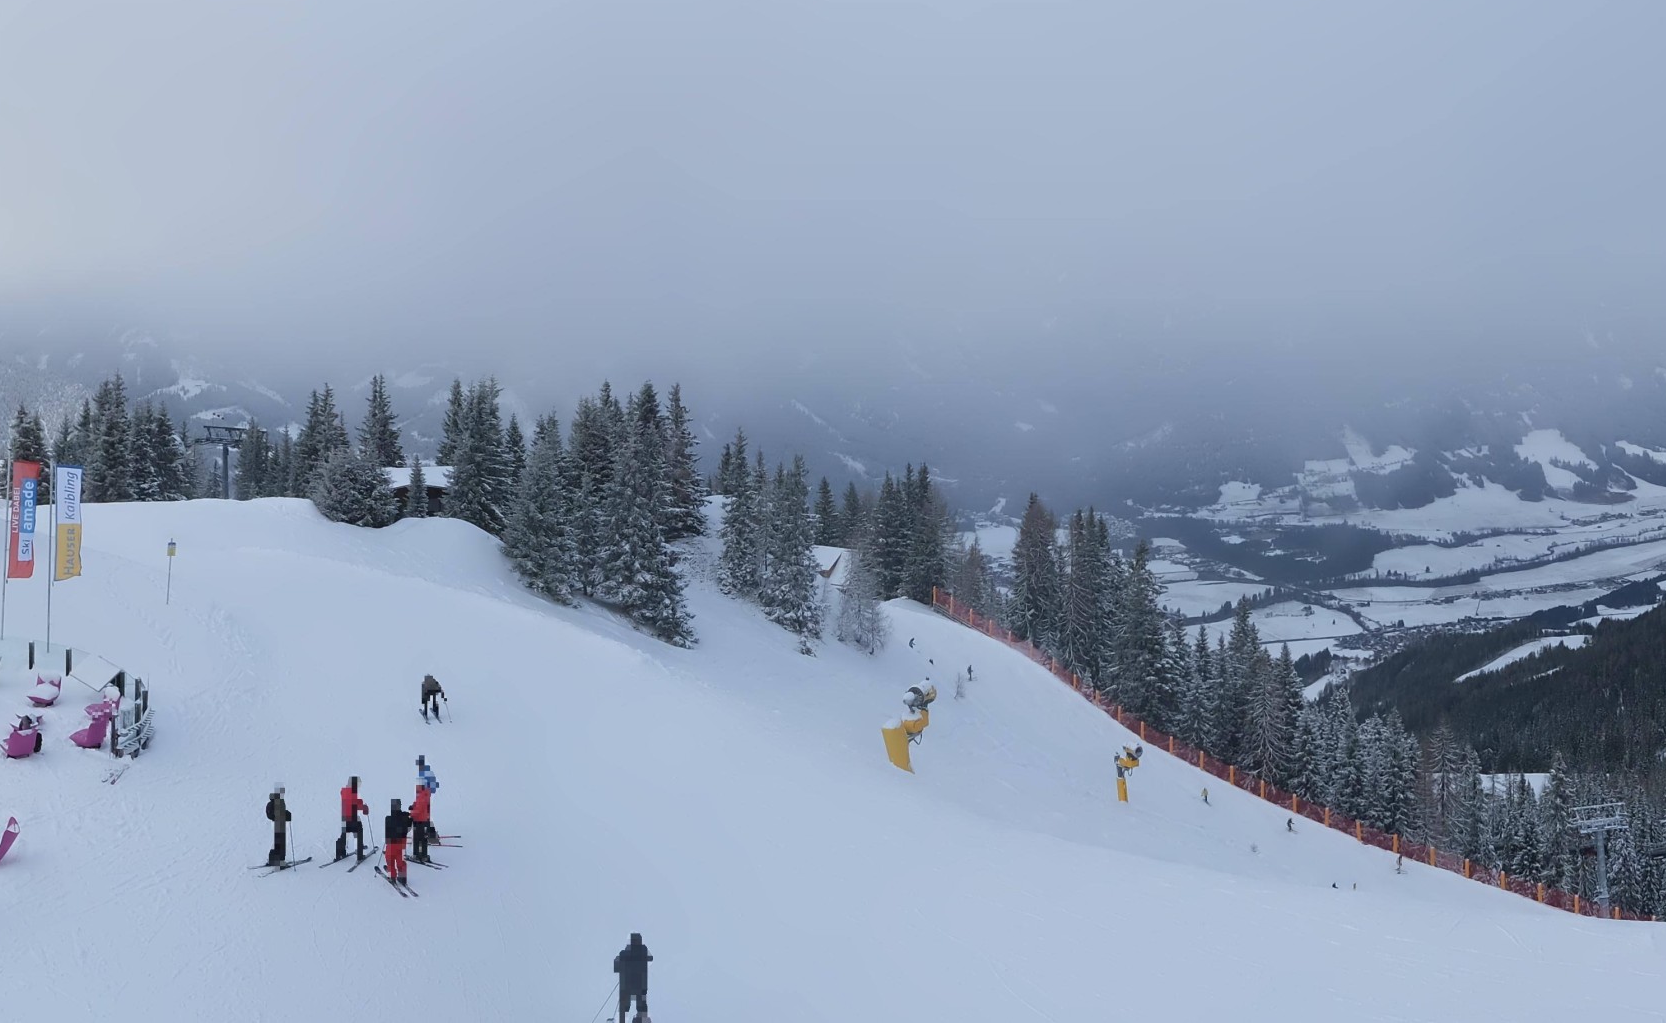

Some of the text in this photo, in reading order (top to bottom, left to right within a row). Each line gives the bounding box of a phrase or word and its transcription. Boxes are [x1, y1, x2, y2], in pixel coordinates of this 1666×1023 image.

[21, 539, 31, 555] Ski
[63, 471, 78, 575] HAUSER Kaibling
